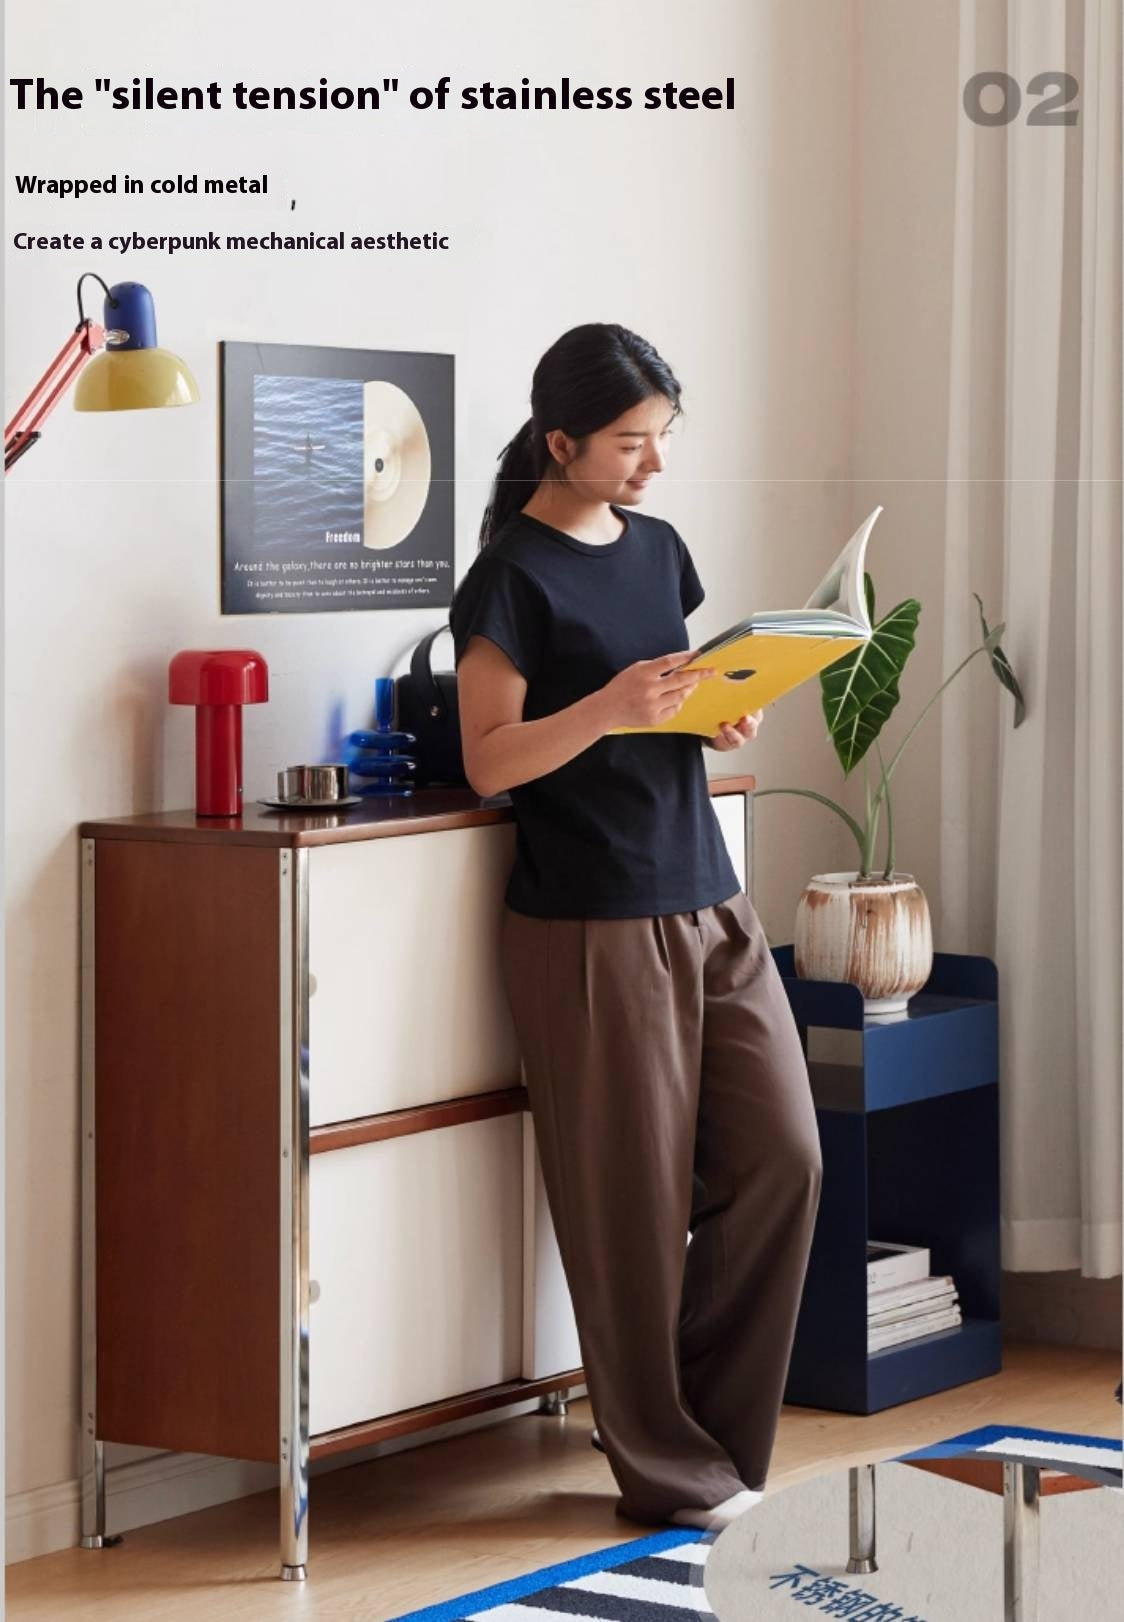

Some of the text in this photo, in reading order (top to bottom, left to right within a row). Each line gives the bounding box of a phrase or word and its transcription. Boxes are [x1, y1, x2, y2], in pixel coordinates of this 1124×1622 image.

[325, 531, 361, 543] Freedom
[233, 561, 263, 572] Around
[265, 560, 280, 571] the
[333, 562, 347, 571] are
[349, 561, 359, 570] no
[360, 560, 394, 571] brighter
[395, 559, 416, 569] stars
[417, 558, 434, 568] than
